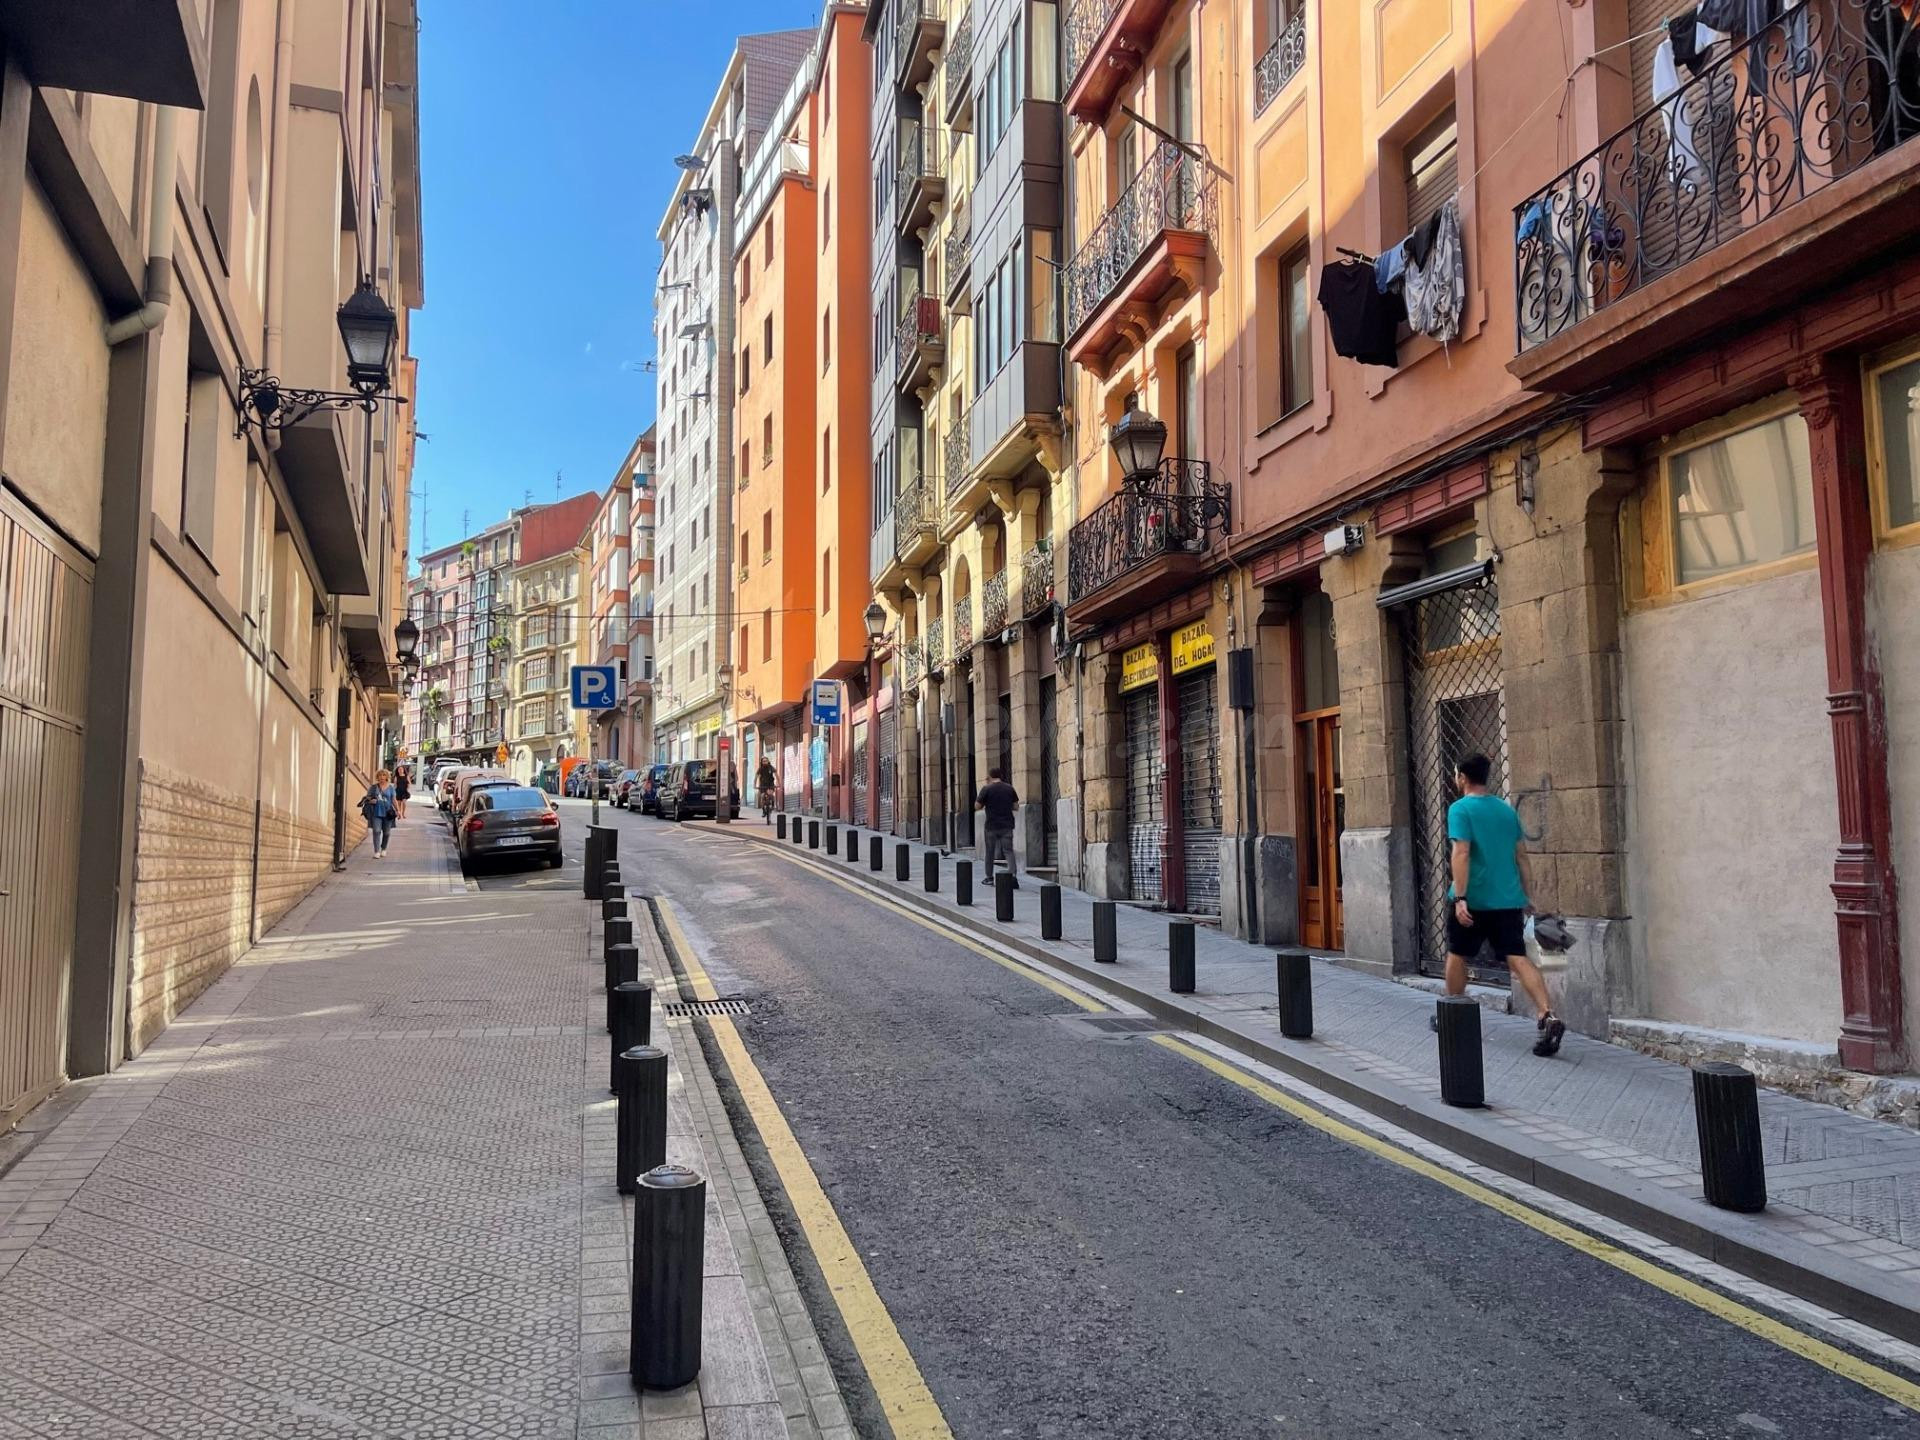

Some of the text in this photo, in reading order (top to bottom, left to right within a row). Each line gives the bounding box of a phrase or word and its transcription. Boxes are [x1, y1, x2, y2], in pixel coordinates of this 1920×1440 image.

[1182, 624, 1206, 645] BAZAR
[1126, 648, 1146, 666] BAZAR
[1174, 654, 1188, 668] DEL
[1124, 664, 1157, 686] ELECTRICIDA
[580, 670, 607, 704] P
